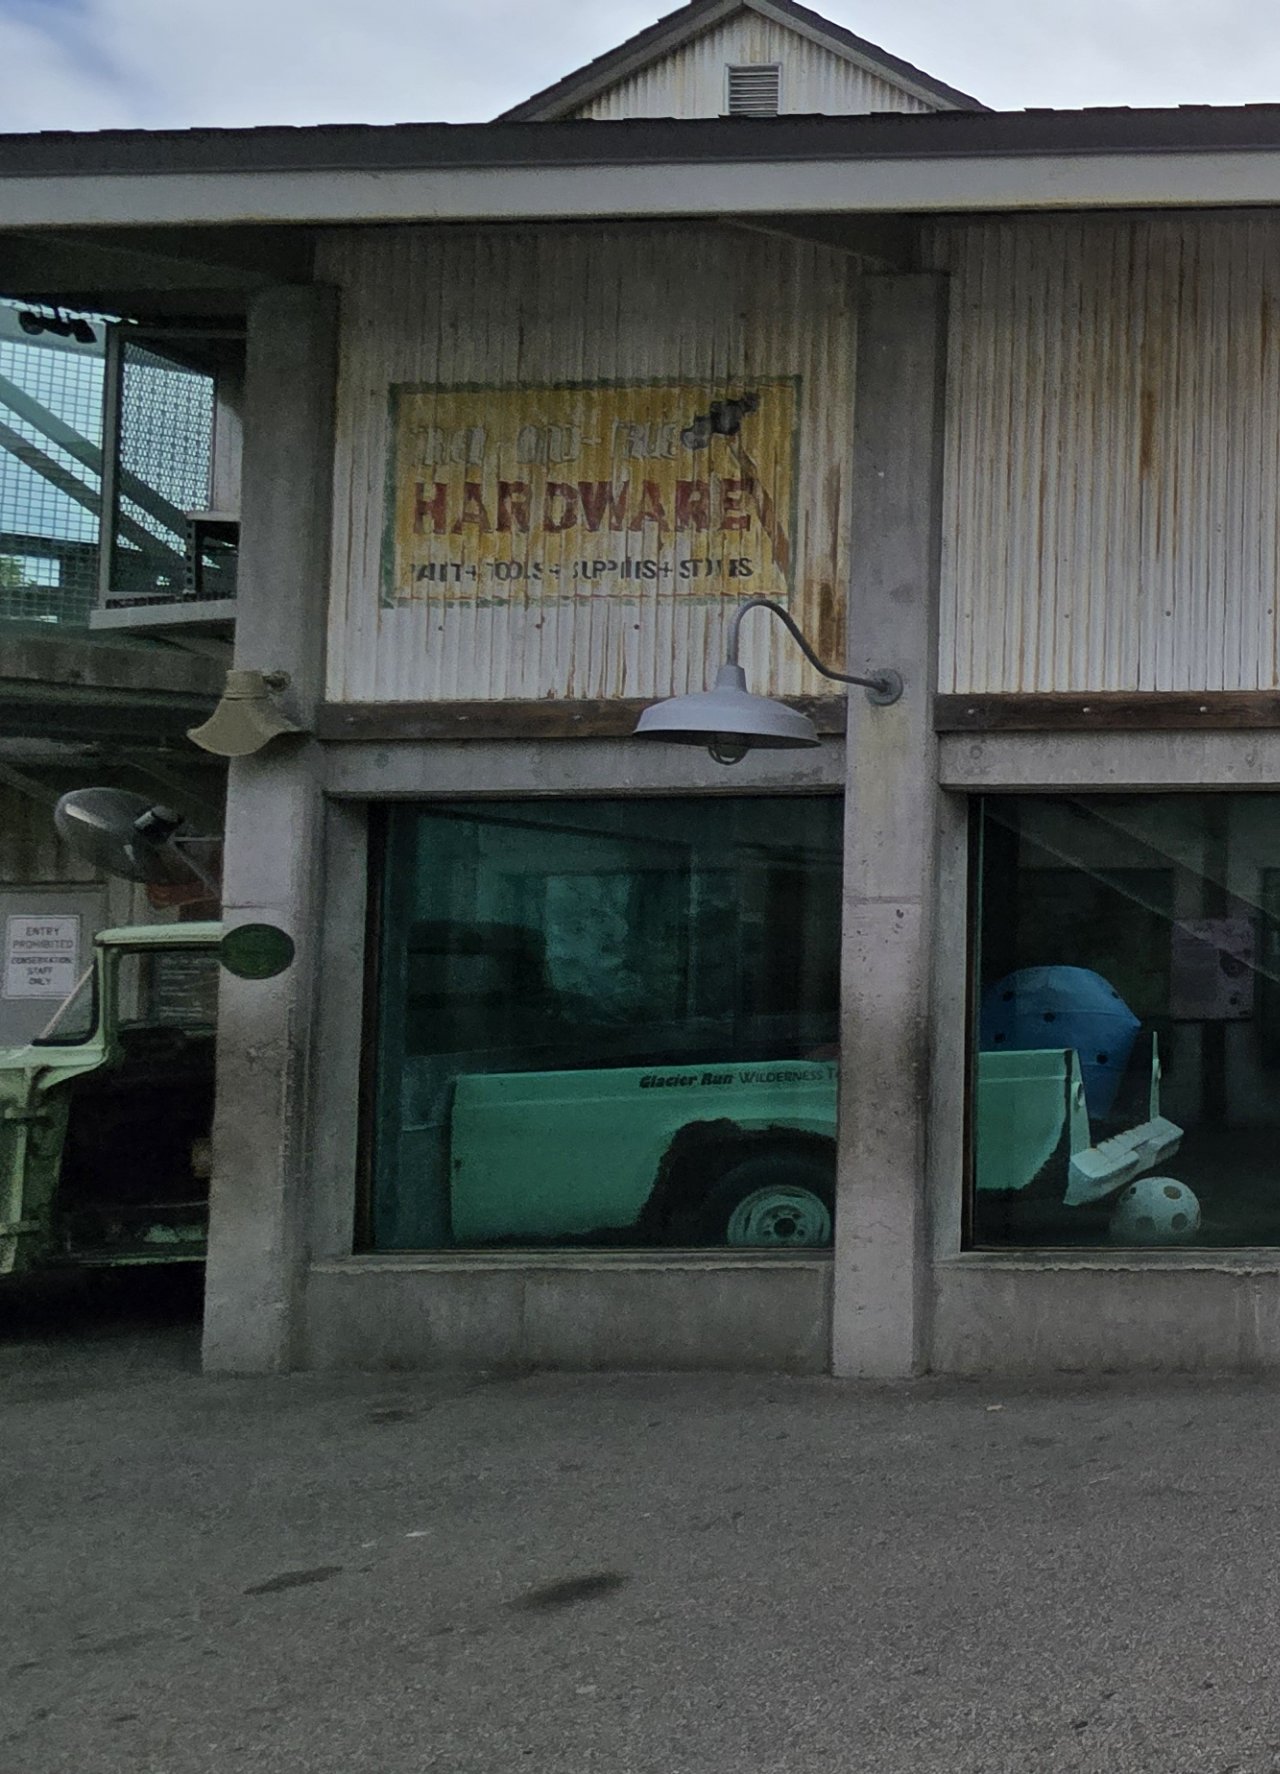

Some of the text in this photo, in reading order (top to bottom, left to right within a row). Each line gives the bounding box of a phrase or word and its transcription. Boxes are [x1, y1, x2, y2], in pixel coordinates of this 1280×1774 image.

[413, 477, 753, 535] HARDWARE
[679, 557, 754, 580] STOES
[26, 926, 59, 937] ENTRY
[13, 939, 73, 949] PROHIBITED
[27, 966, 54, 975] STAFF
[639, 1073, 698, 1088] Glacier
[701, 1071, 735, 1086] Run
[738, 1069, 823, 1085] WILDERNESS
